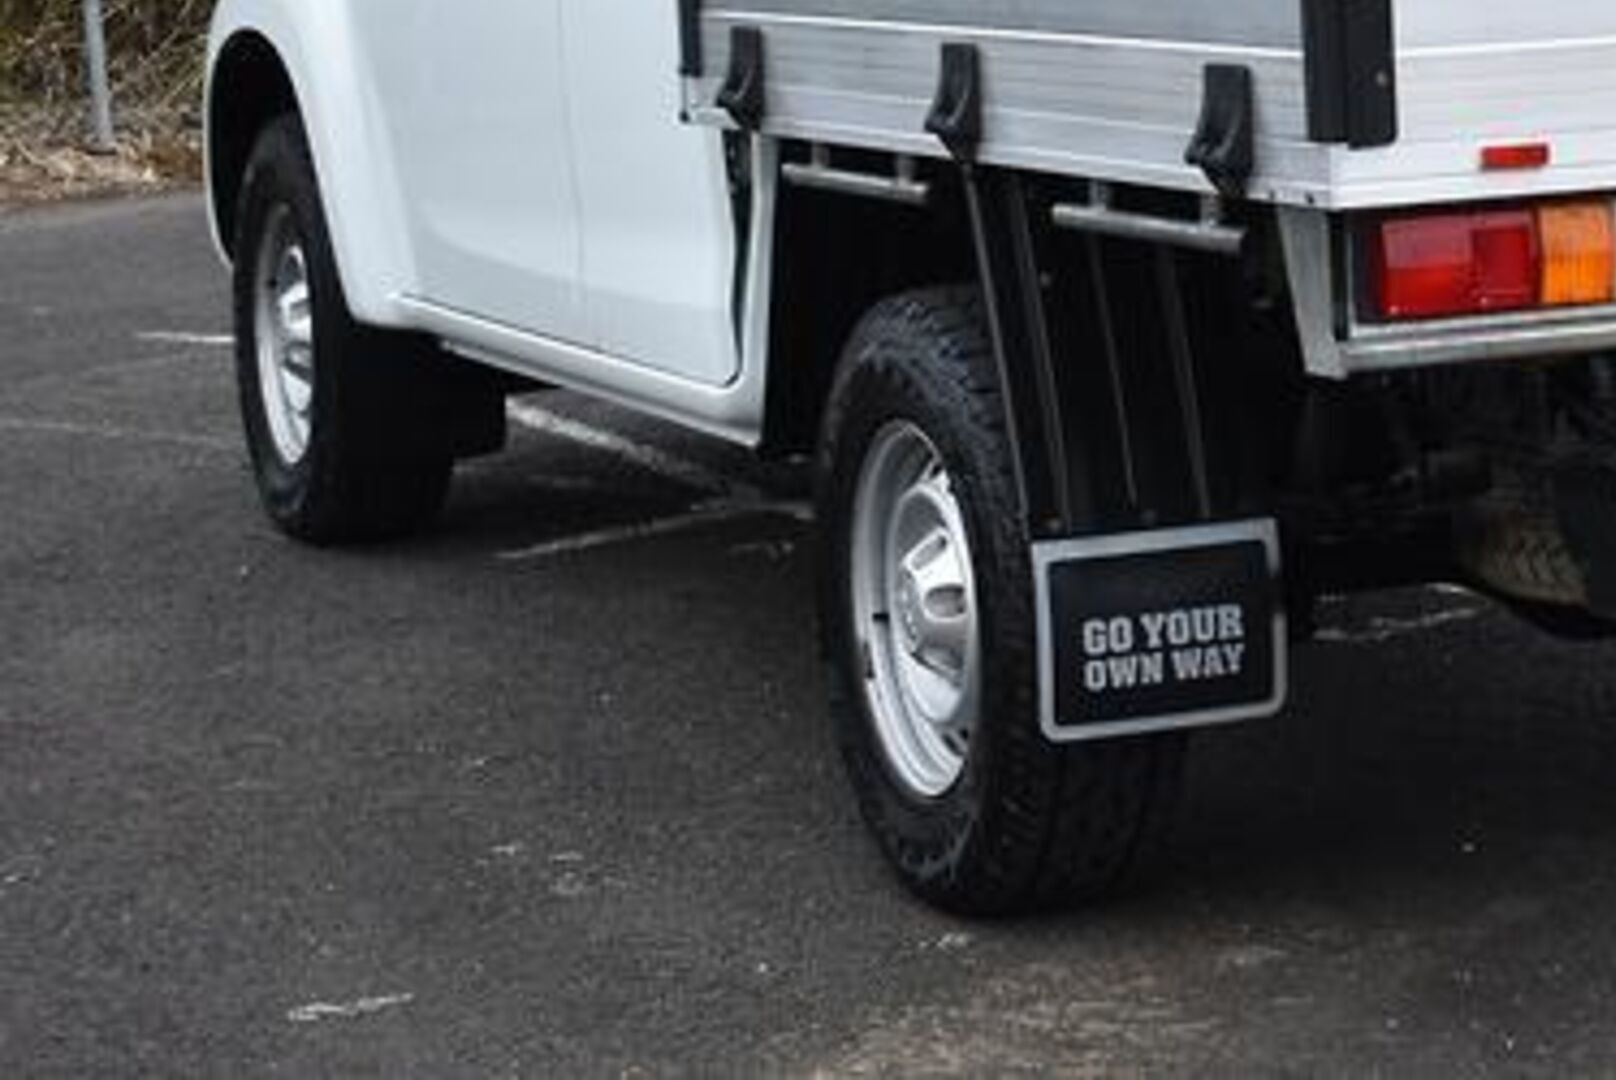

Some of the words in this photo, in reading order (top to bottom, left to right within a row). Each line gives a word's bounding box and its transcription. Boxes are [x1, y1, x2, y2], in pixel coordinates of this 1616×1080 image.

[1083, 617, 1133, 655] GO
[1140, 604, 1243, 648] YOUR
[1084, 651, 1163, 691] OWN
[1171, 643, 1244, 680] WAY
